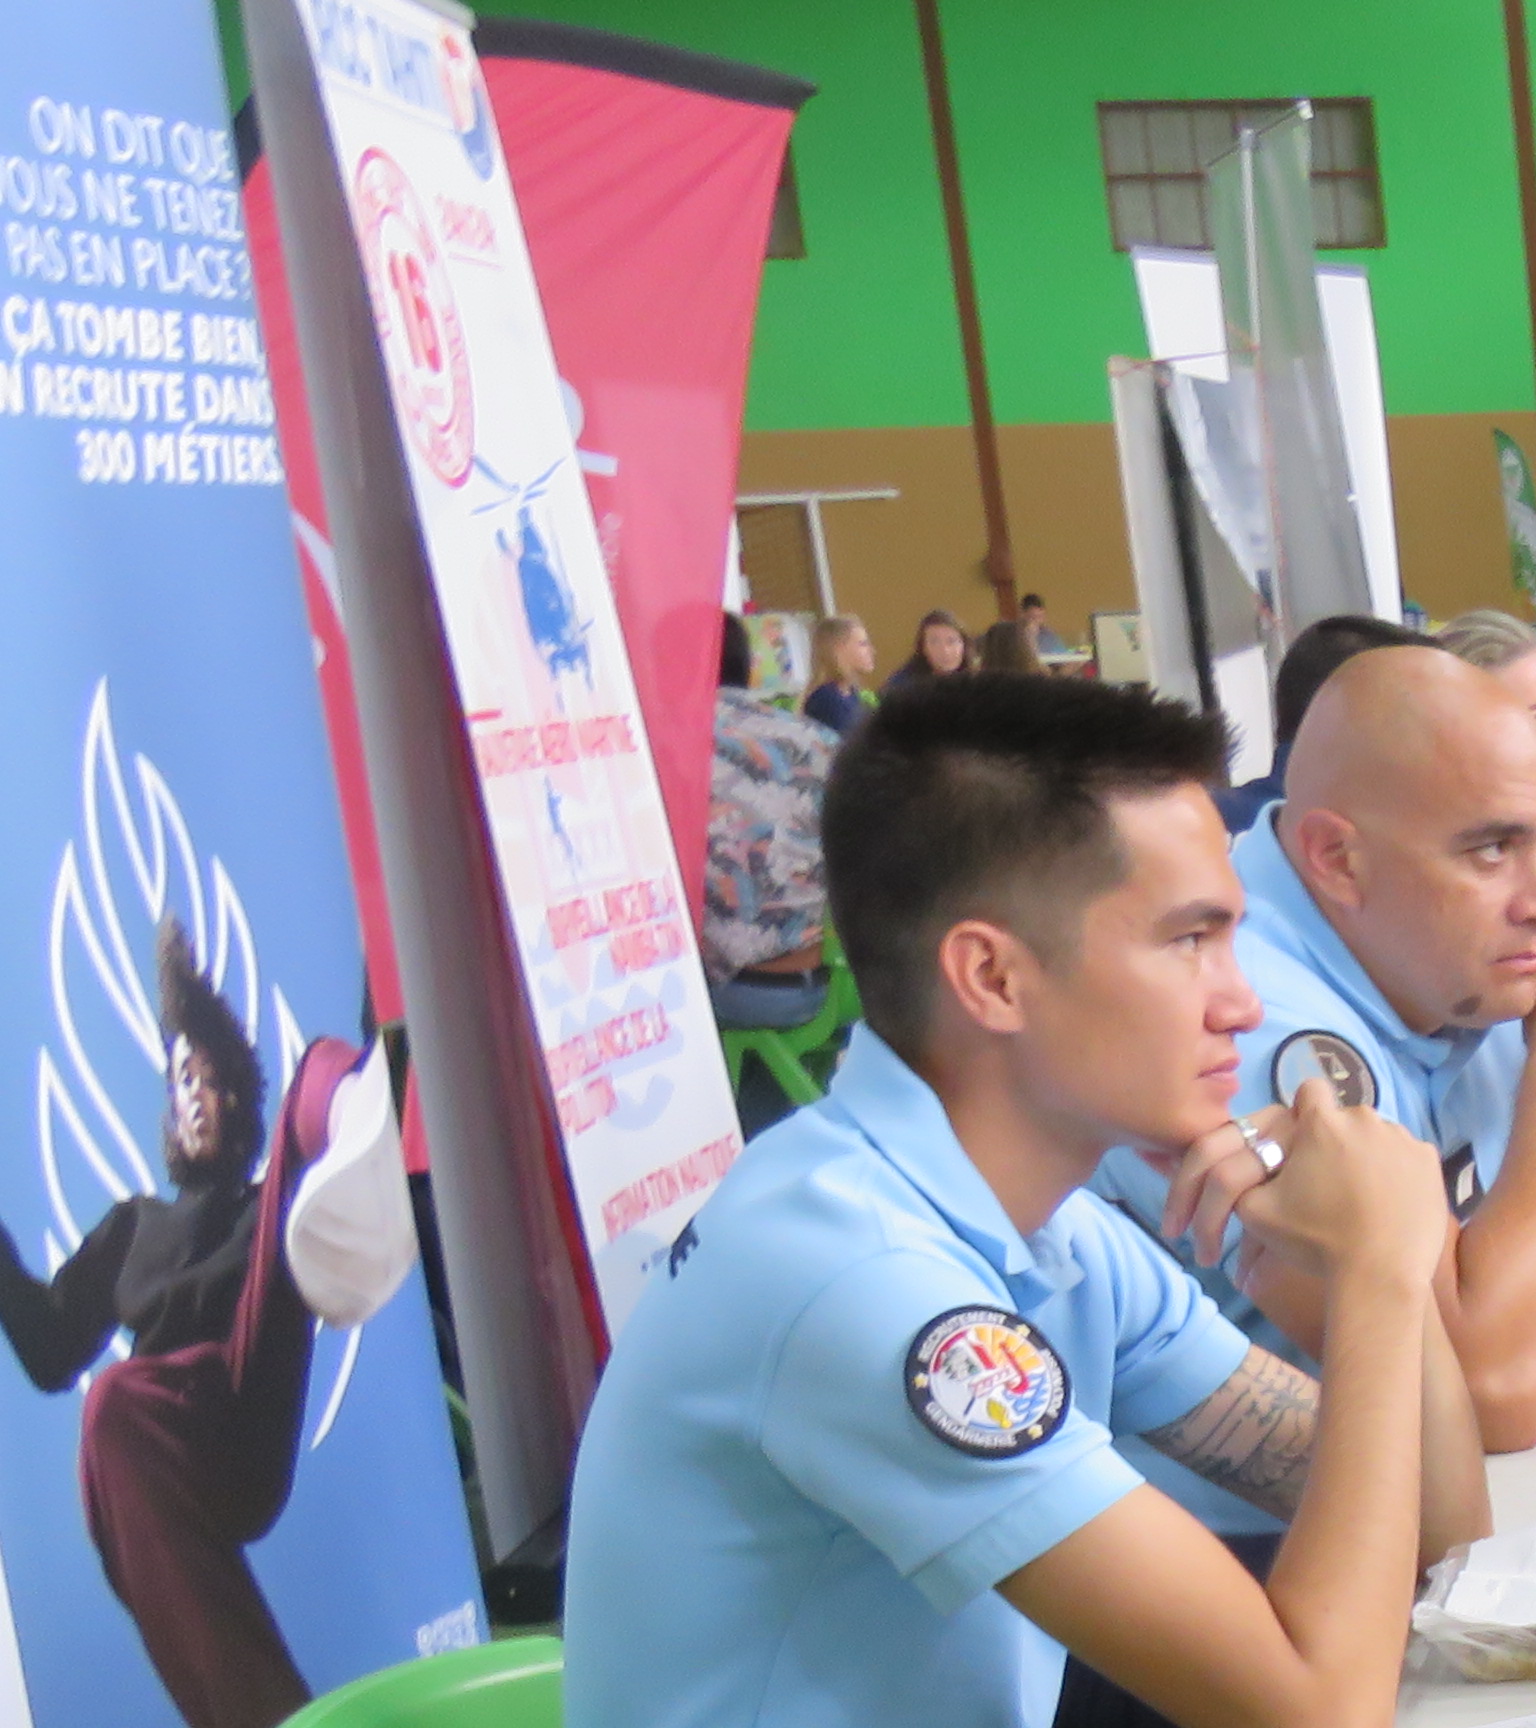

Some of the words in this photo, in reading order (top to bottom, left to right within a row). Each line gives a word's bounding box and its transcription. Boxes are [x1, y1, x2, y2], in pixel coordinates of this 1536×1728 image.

[29, 97, 96, 159] ON
[102, 110, 164, 167] DIT
[170, 121, 235, 181] QUE
[0, 156, 80, 220] OUS
[82, 168, 143, 228] NE
[5, 222, 69, 283] PAS
[69, 230, 127, 288] EN
[4, 294, 56, 366] ÇA
[56, 302, 185, 363] TOMBE
[0, 360, 26, 416] N
[32, 362, 188, 422] RECRUTE
[193, 375, 276, 428] DANS
[75, 428, 137, 485] 300
[142, 420, 288, 485] MÉTIERS
